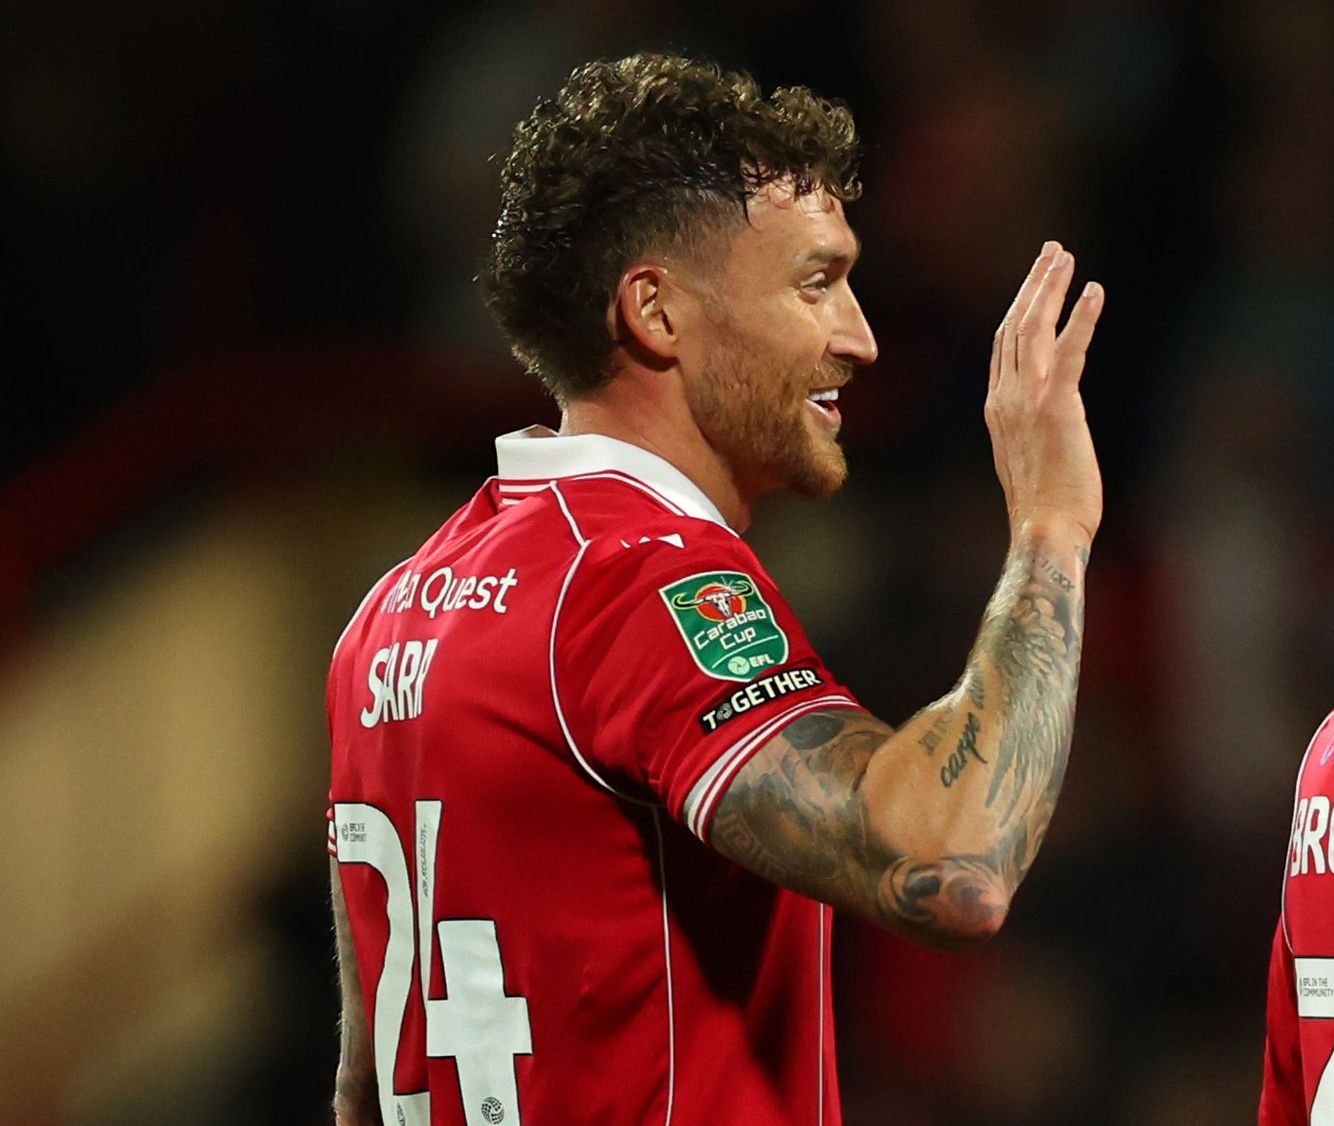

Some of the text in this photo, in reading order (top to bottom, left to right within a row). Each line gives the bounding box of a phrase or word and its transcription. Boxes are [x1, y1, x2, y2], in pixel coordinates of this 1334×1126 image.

[420, 566, 518, 619] Quest
[693, 608, 767, 650] Carabao
[719, 626, 757, 650] Cup
[749, 653, 775, 668] EFL
